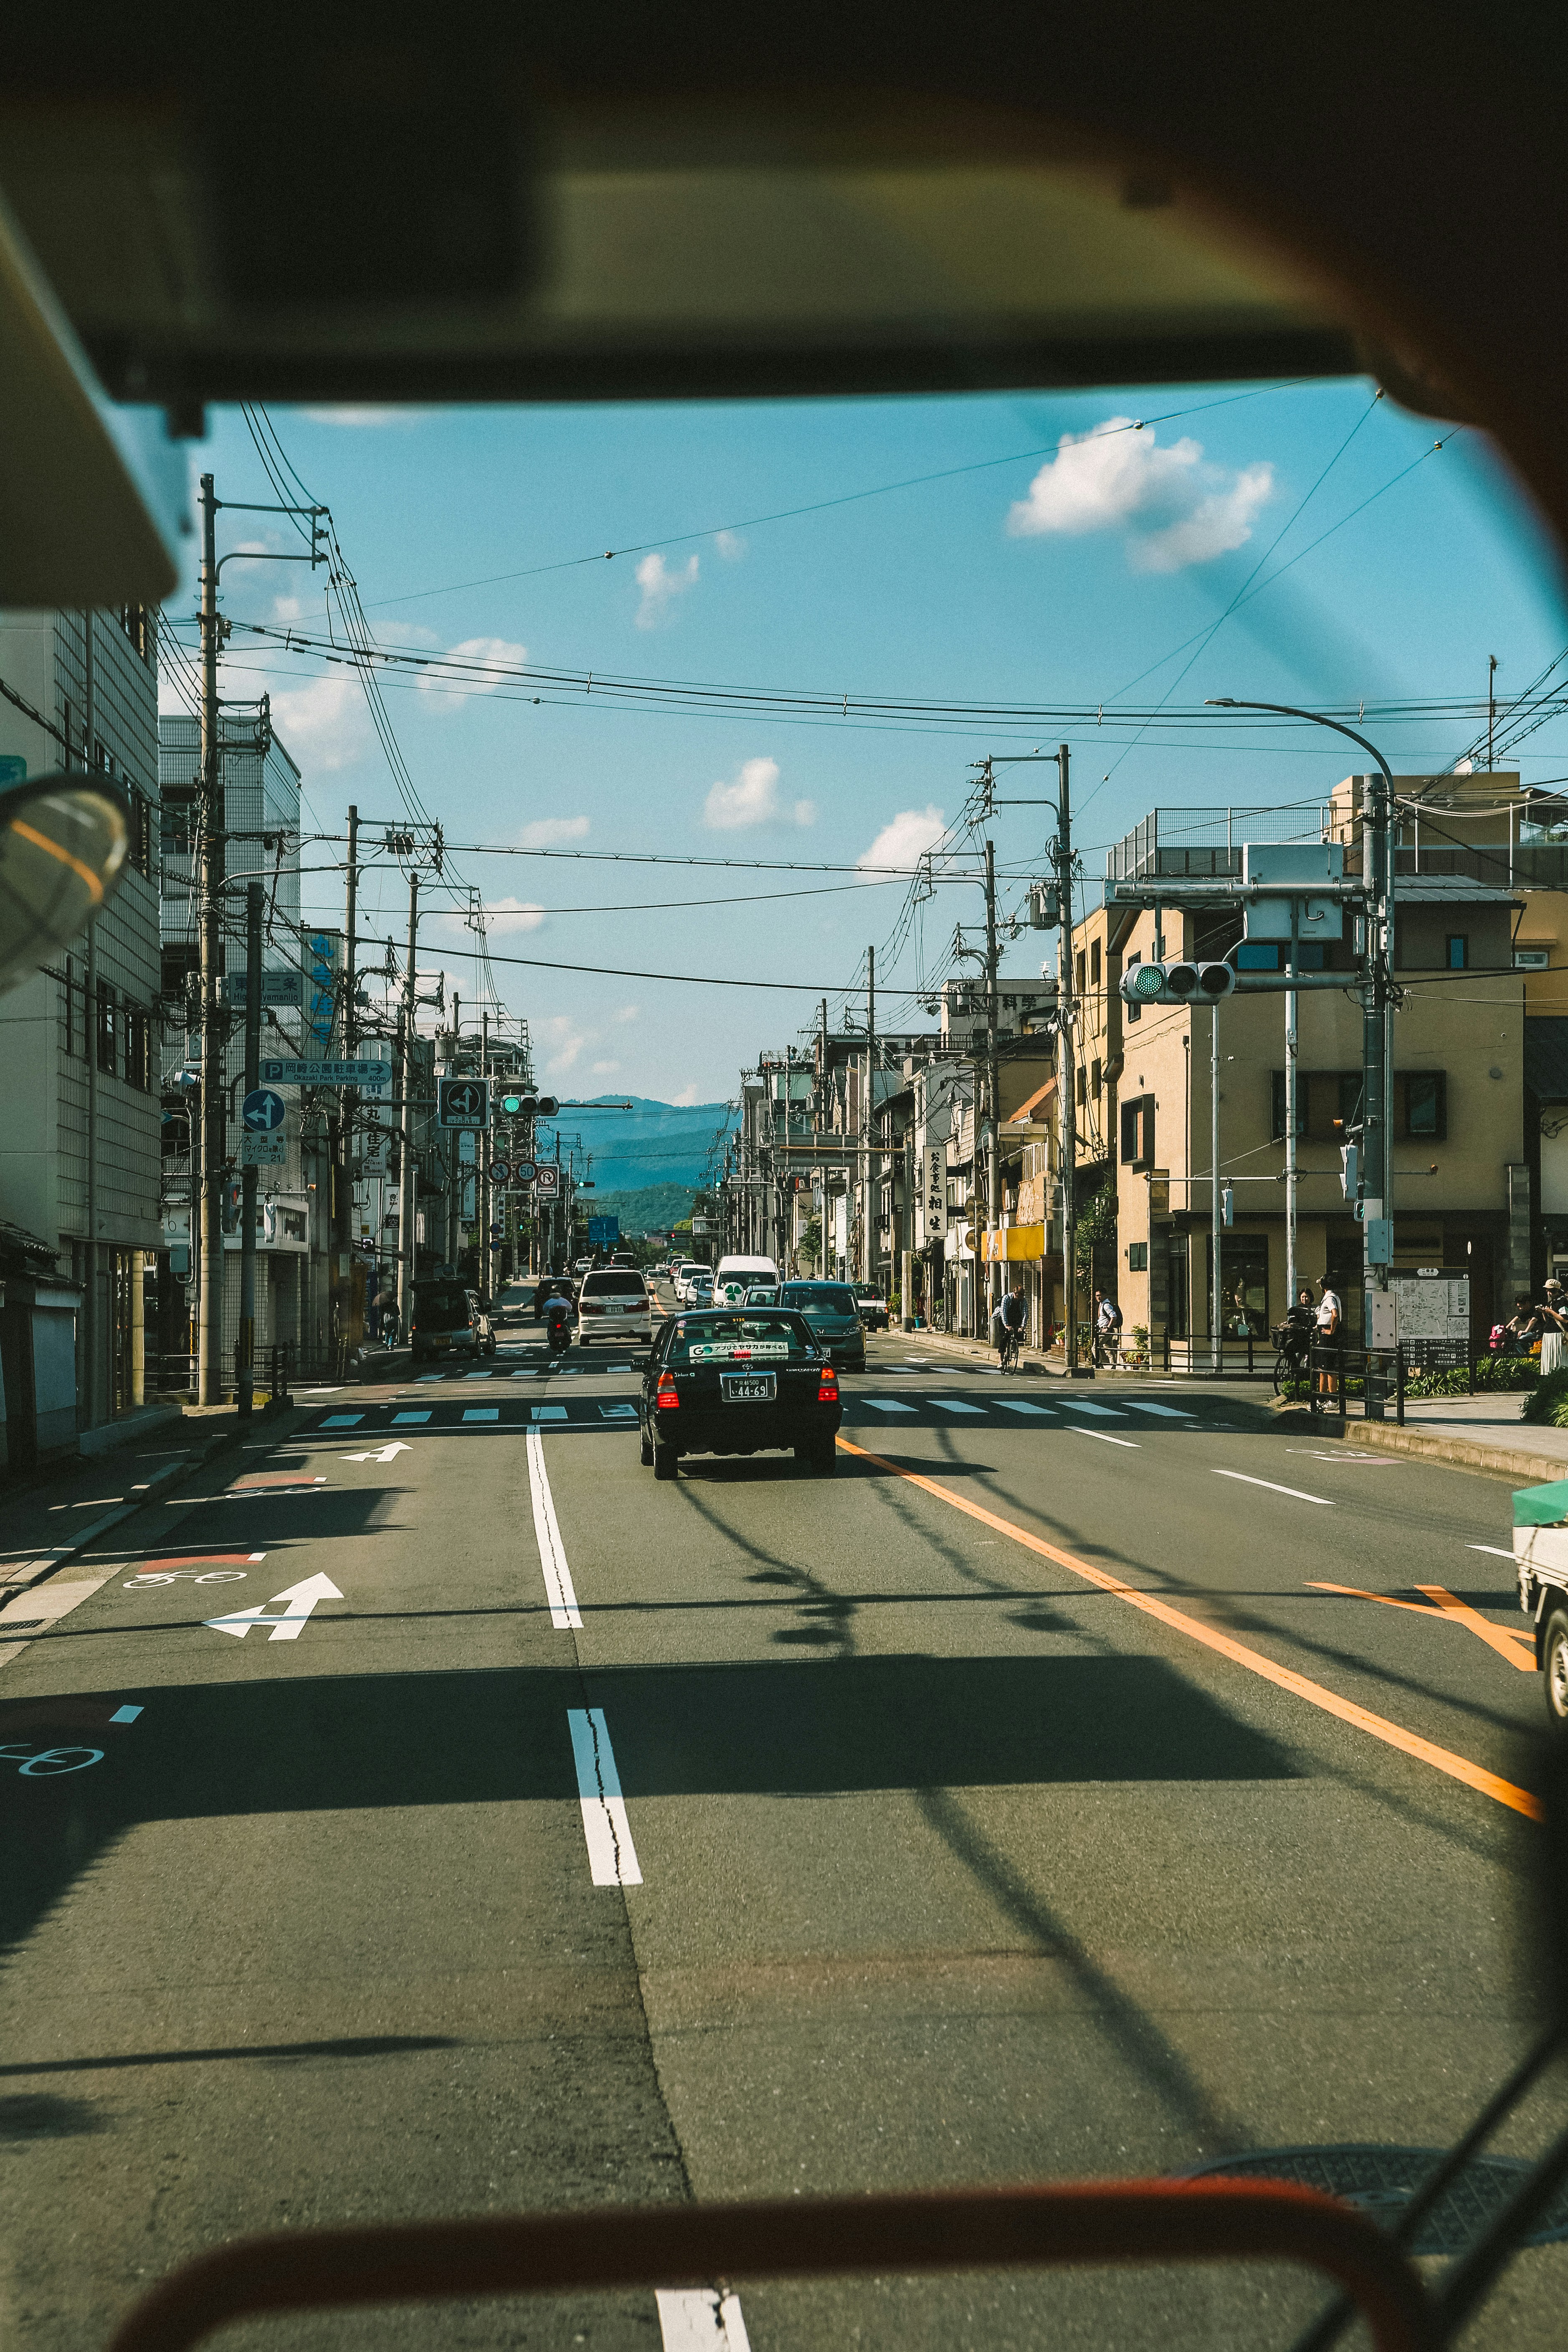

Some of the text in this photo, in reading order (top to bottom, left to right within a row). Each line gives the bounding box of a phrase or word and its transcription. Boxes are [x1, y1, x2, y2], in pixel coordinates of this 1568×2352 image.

[235, 977, 297, 991] 東二条
[285, 1063, 368, 1074] 岡崎公園駐車場
[520, 1166, 534, 1177] 50
[928, 1195, 942, 1231] 相生
